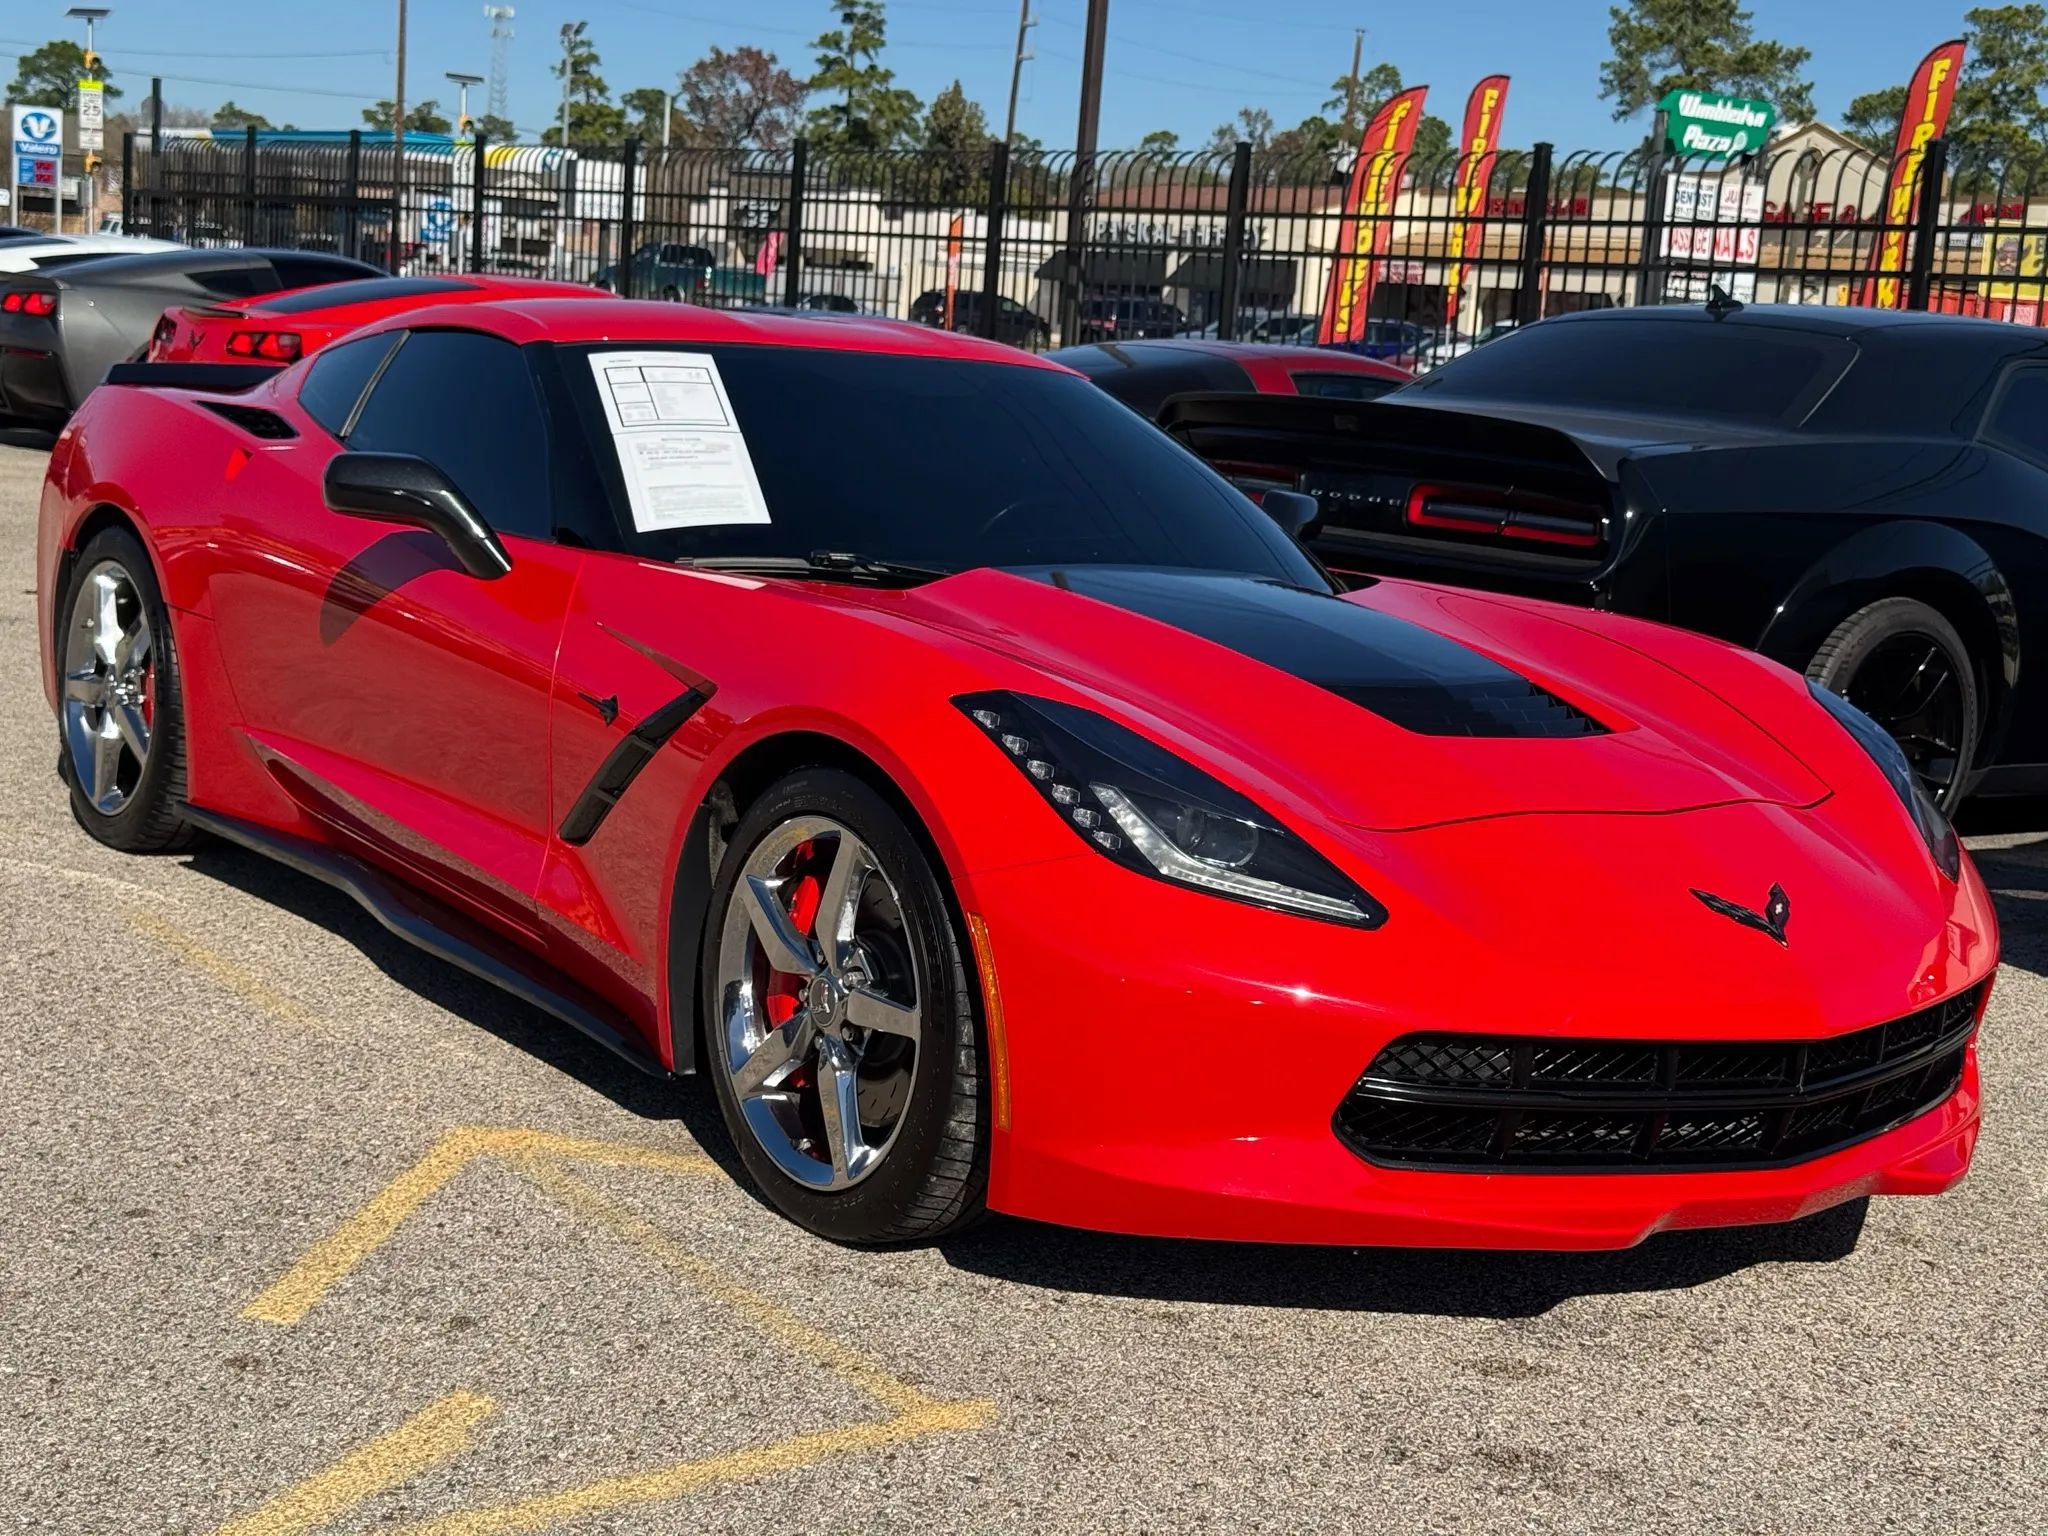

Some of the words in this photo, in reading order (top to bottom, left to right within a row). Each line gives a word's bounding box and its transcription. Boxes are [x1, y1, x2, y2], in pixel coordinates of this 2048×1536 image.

[1679, 93, 1767, 128] Wimbledon
[20, 142, 58, 156] Valero
[1683, 124, 1733, 152] Plaza
[1876, 58, 1952, 309] FIREWORK
[1675, 190, 1713, 208] DENST
[1670, 227, 1706, 254] ASSGE
[1714, 228, 1756, 259] NALS
